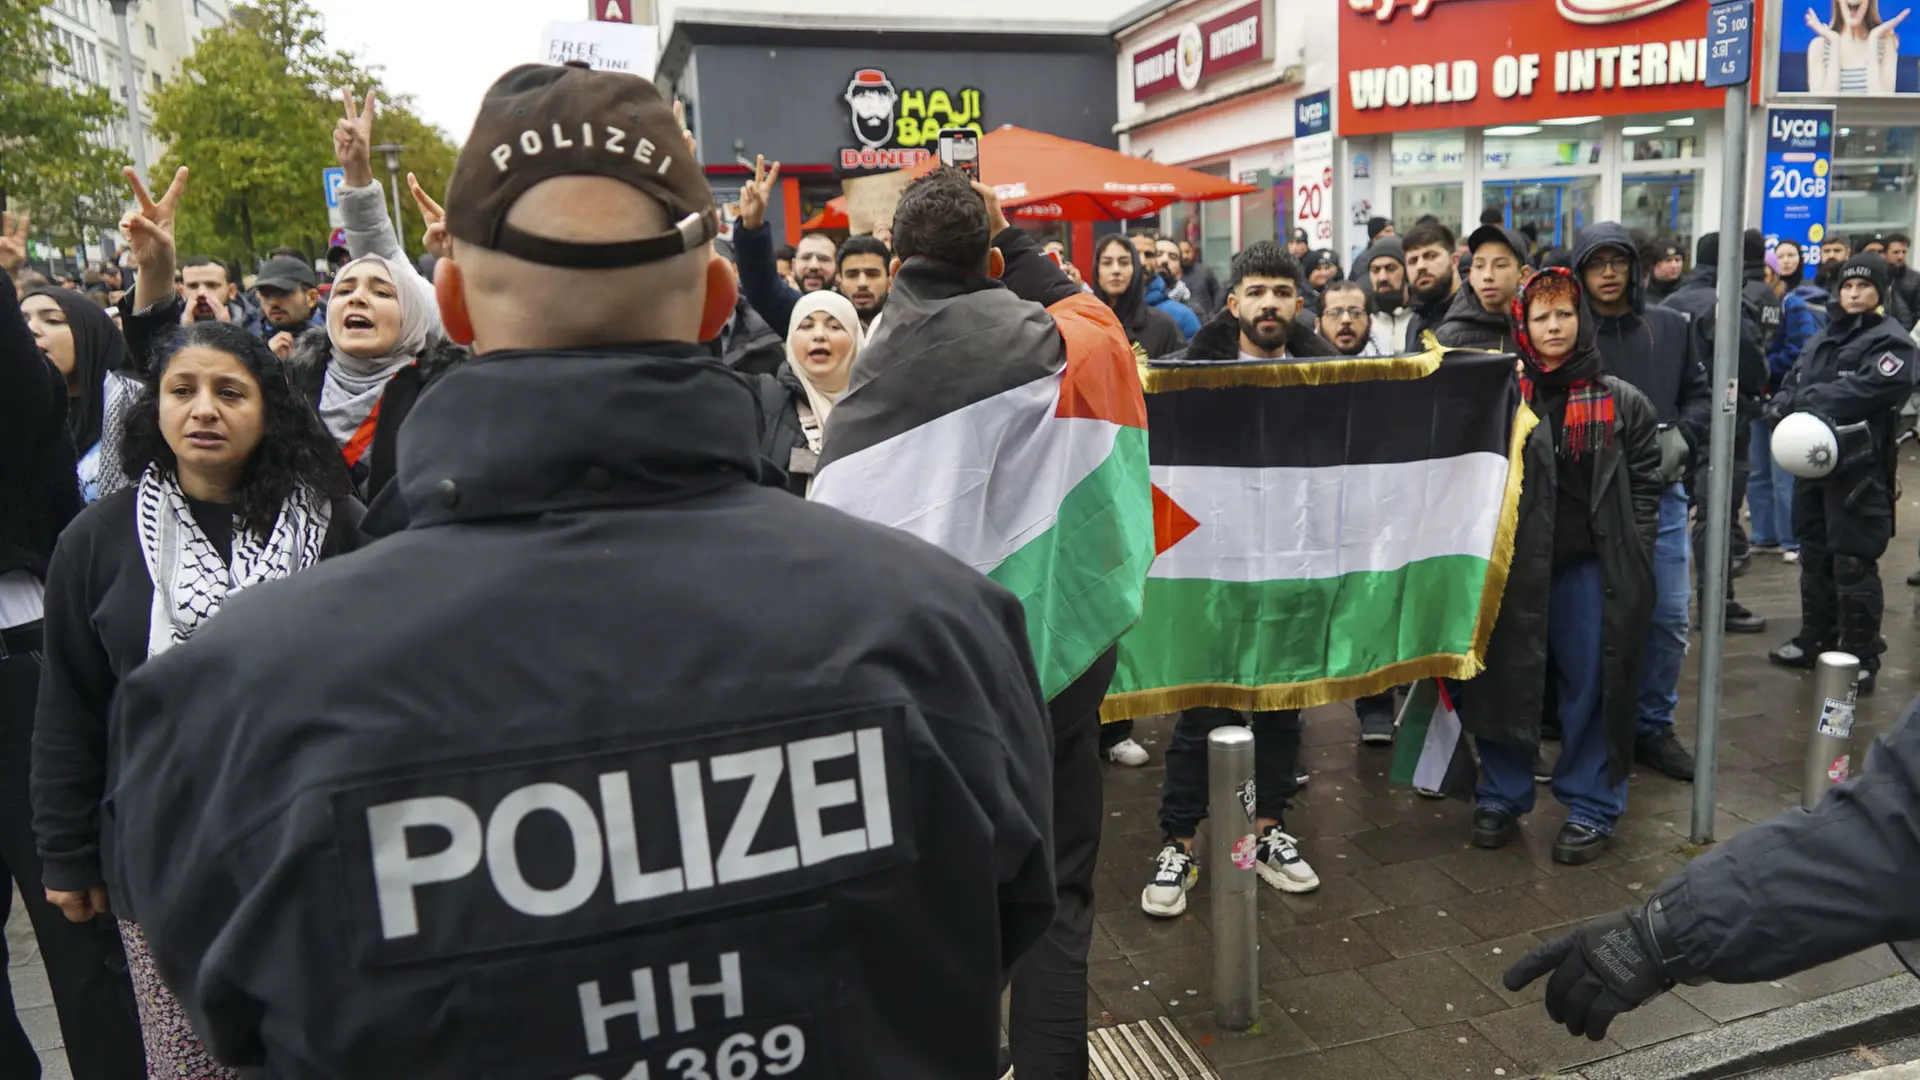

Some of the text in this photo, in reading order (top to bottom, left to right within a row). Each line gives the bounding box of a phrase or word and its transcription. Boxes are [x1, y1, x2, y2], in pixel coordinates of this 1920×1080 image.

[605, 0, 623, 20] A
[1717, 15, 1748, 34] S 100
[550, 39, 601, 55] FREE
[1209, 15, 1258, 61] INTERNET
[1349, 59, 1478, 110] WORLD
[1493, 53, 1539, 98] OF
[900, 88, 981, 125] HAJI
[1299, 102, 1323, 125] Lyca
[1772, 115, 1818, 142] Lyca
[490, 122, 673, 175] POLIZEI
[1769, 169, 1826, 198] 20GB
[1298, 184, 1321, 219] 20
[1843, 265, 1872, 277] POLIZEI
[367, 727, 894, 940] POLIZEI
[577, 951, 744, 1055] HH
[568, 1024, 805, 1080] 369
